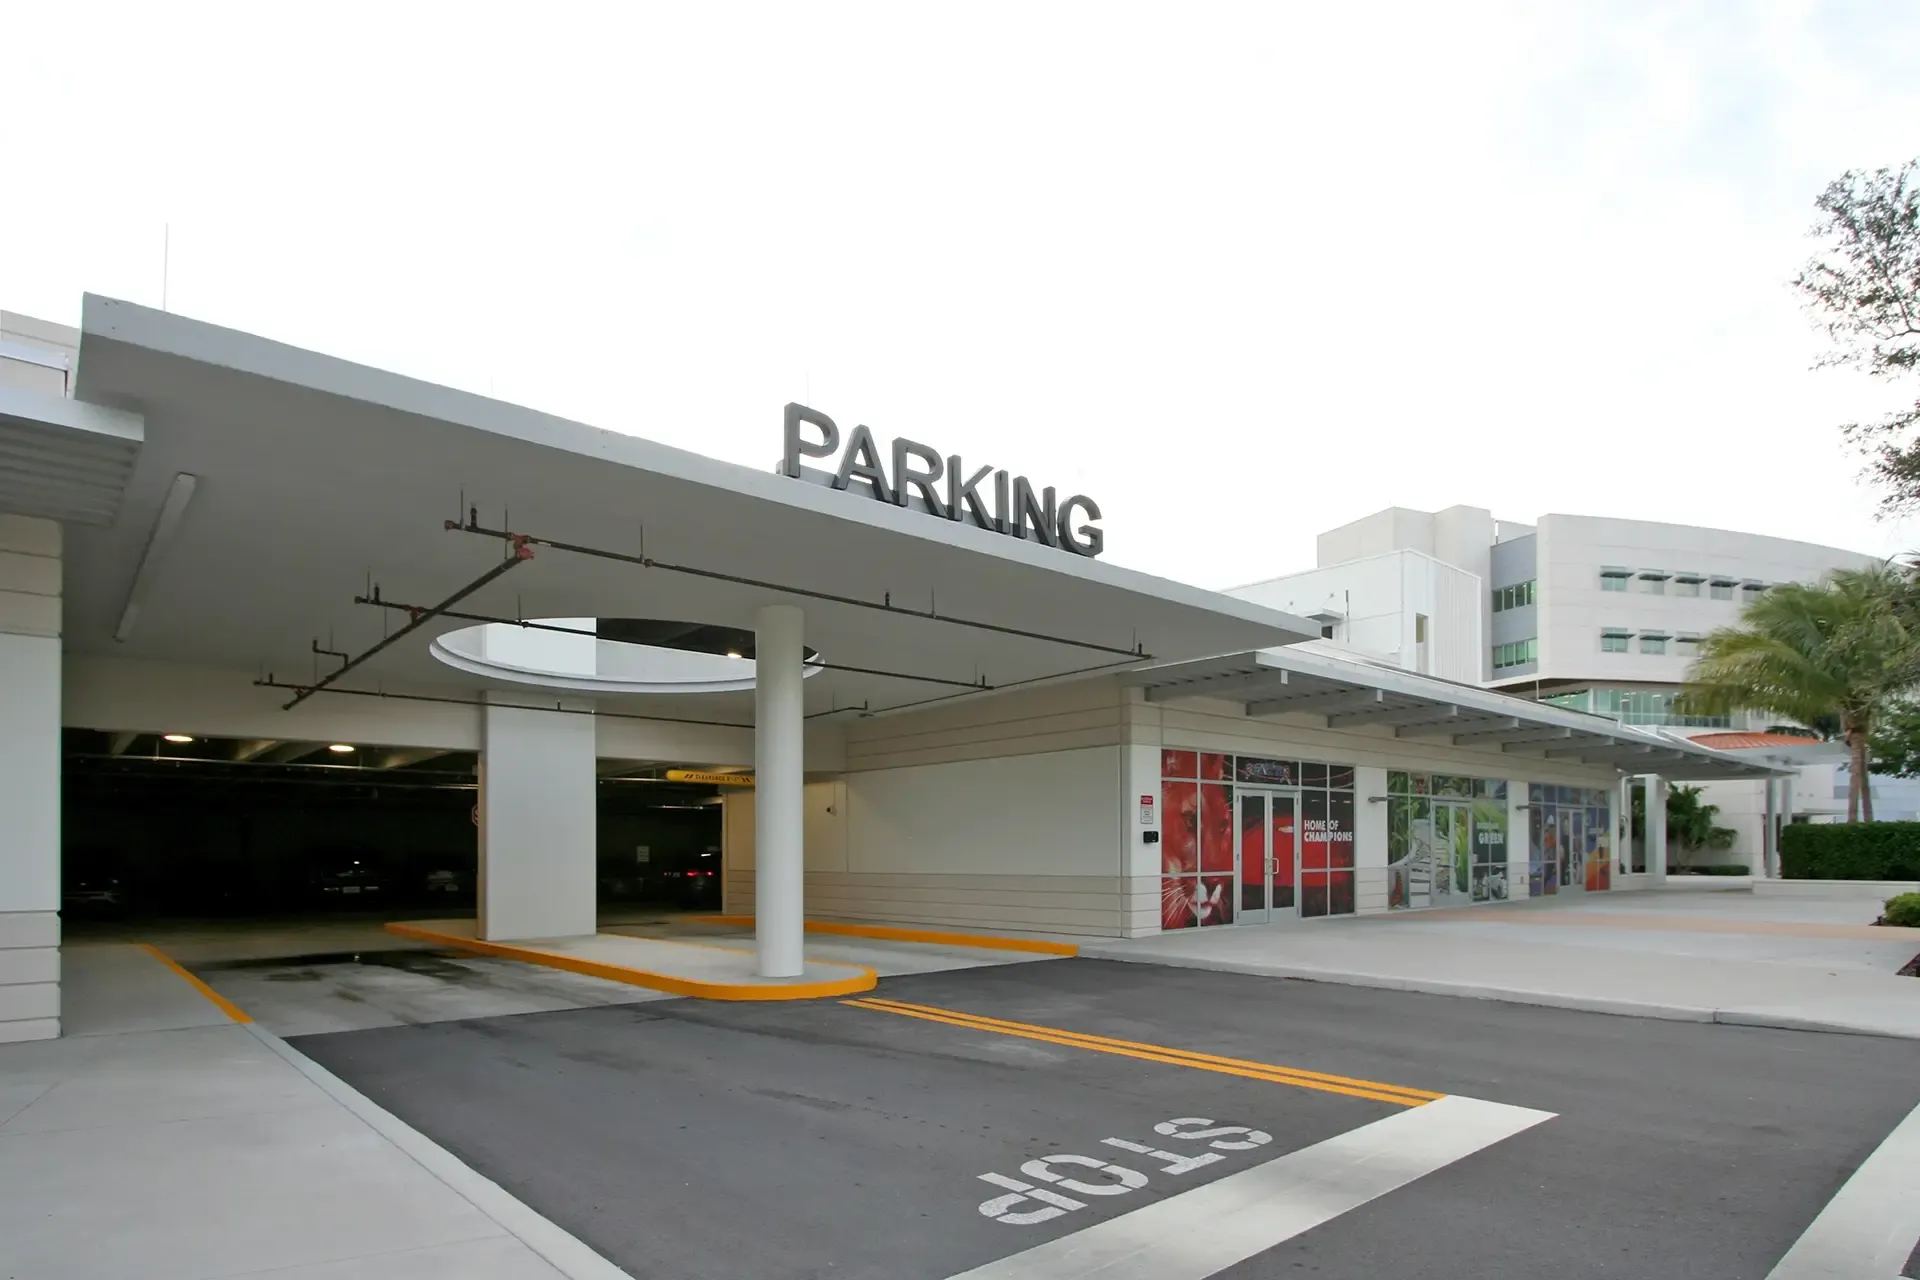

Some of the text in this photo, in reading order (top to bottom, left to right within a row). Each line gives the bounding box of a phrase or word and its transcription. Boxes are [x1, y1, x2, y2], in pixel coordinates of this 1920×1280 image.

[784, 401, 1104, 559] PARKING
[1303, 820, 1339, 831] HOME OF
[1303, 831, 1353, 842] CHAMPIONS
[976, 1117, 1273, 1226] STOP
